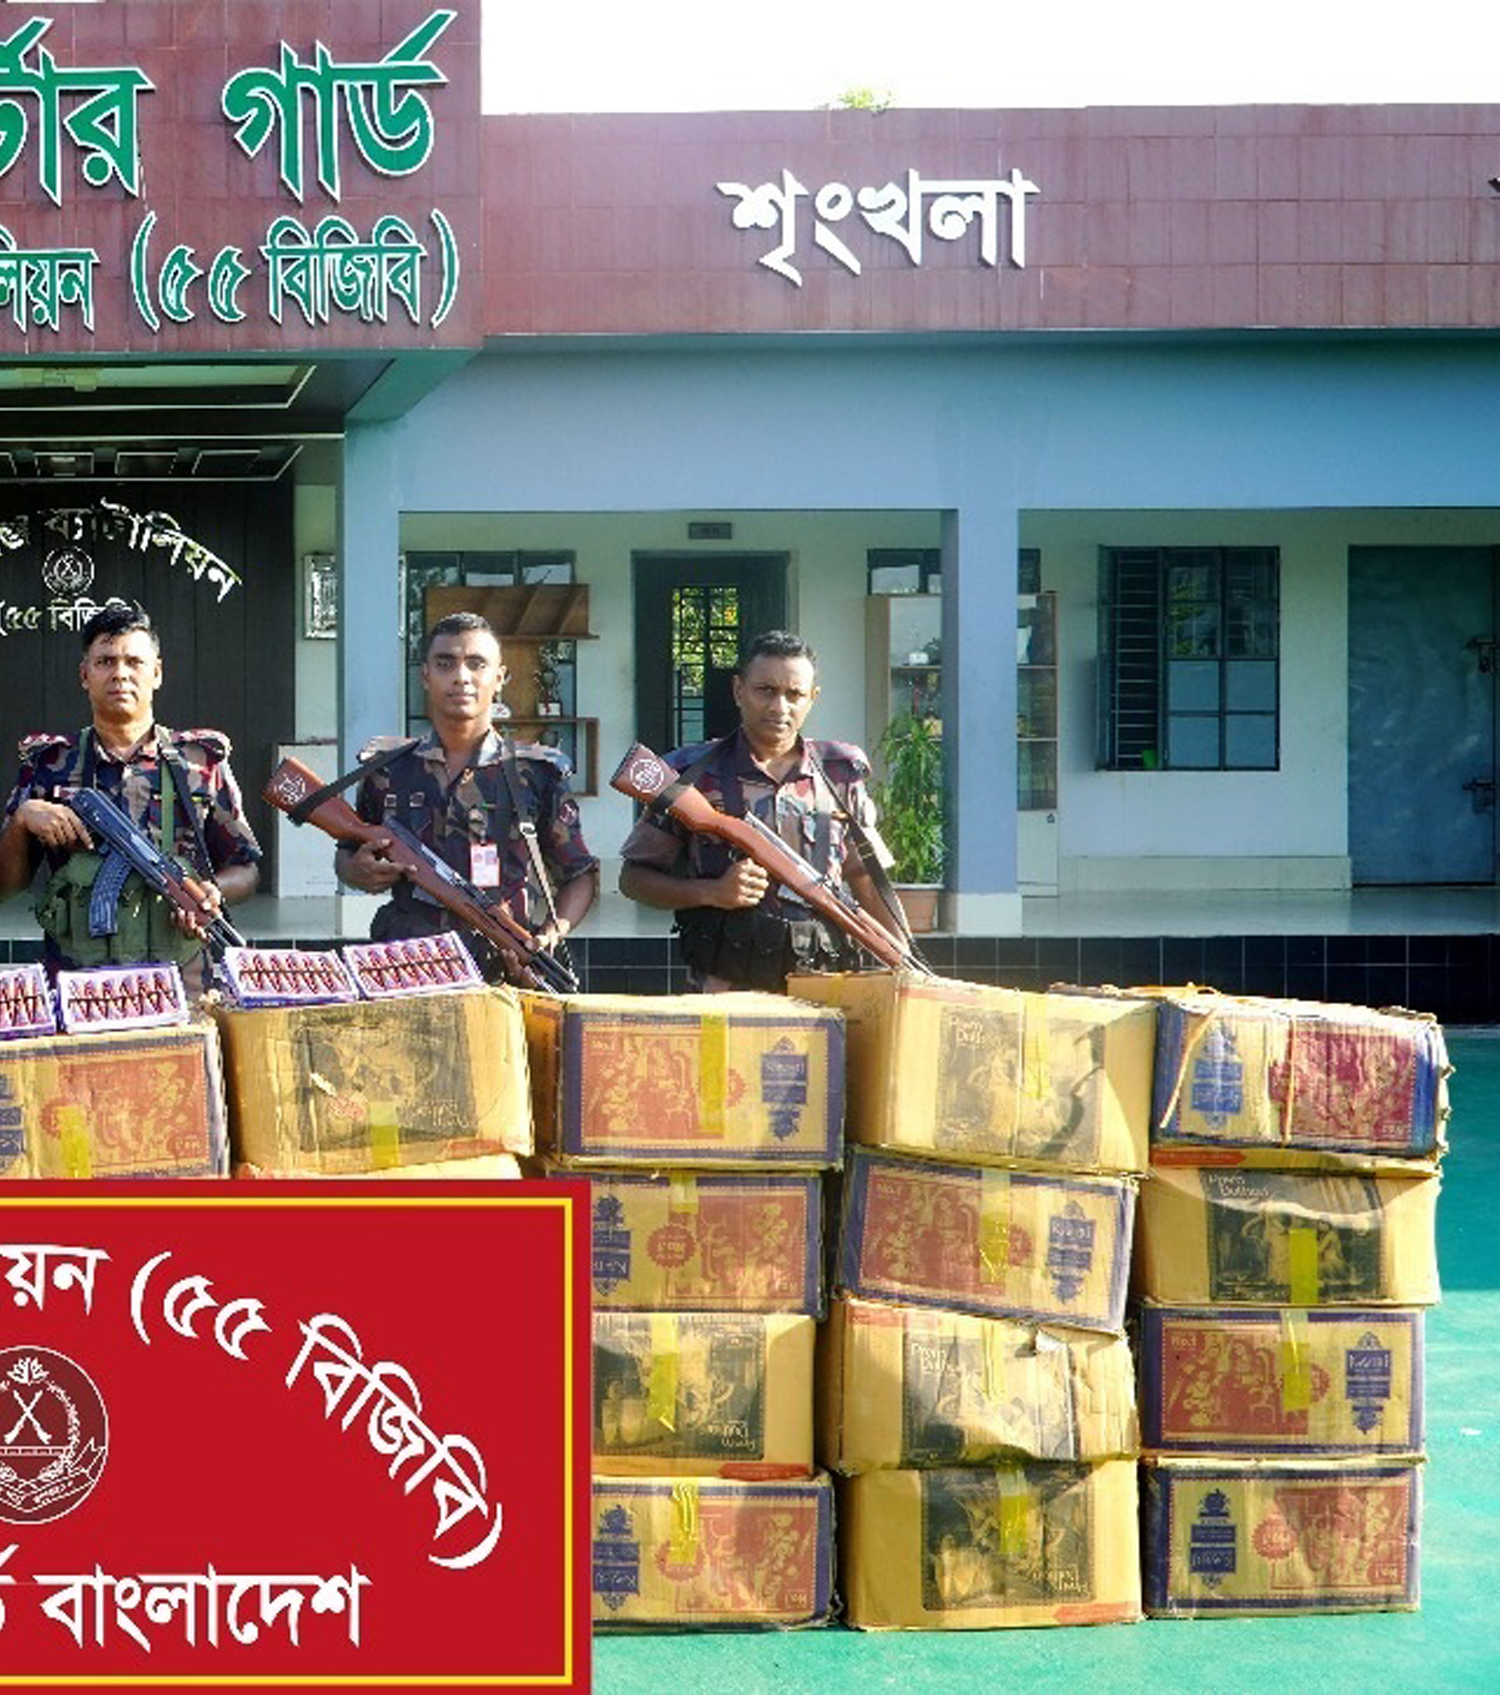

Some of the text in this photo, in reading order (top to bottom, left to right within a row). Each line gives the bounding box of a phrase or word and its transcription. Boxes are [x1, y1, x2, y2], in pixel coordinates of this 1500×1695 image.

[222, 10, 457, 202] গার্ড
[131, 211, 251, 331] (৫৫
[260, 209, 459, 328] বিজিবি)
[717, 167, 1040, 286] শৃংখলা
[658, 1242, 685, 1253] No.1
